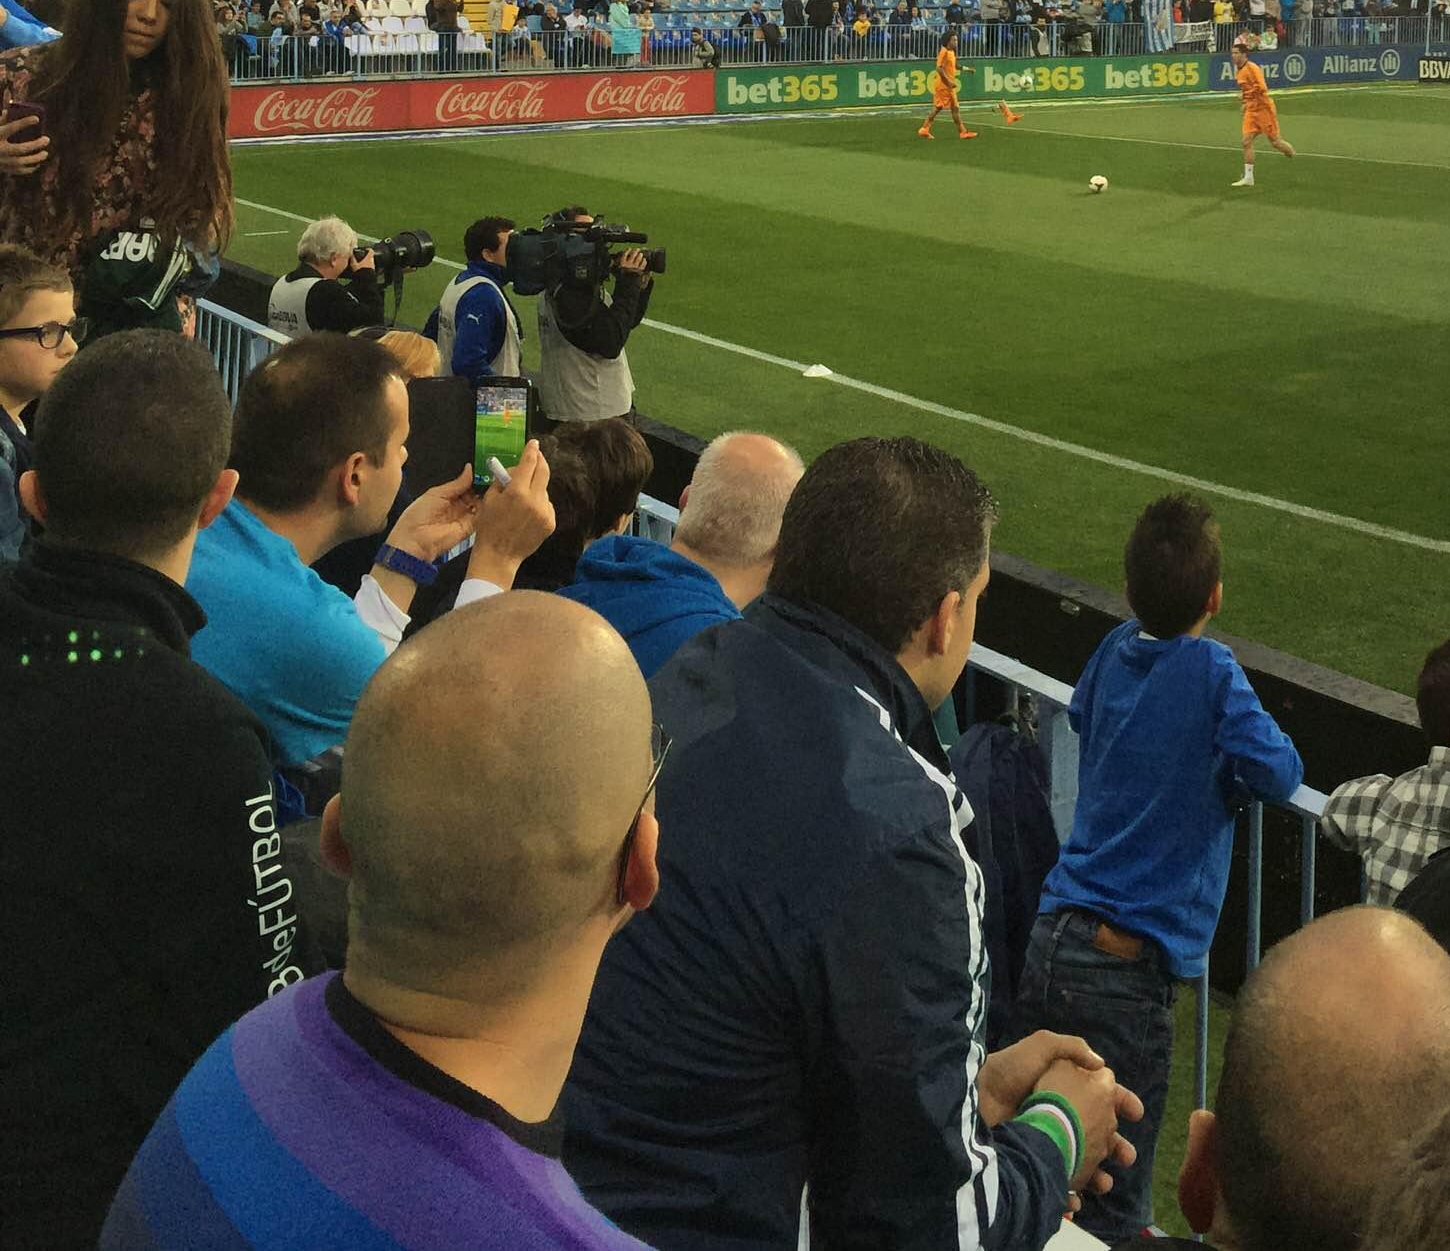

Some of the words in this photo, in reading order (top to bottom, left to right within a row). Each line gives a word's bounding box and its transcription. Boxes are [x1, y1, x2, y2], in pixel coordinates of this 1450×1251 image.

[1105, 61, 1199, 88] bet365
[1323, 55, 1378, 74] Allianz
[435, 80, 550, 122] Coca-Cola
[585, 75, 689, 114] Coca-Cola
[727, 74, 839, 105] bet365
[254, 87, 381, 131] Coca-Cola
